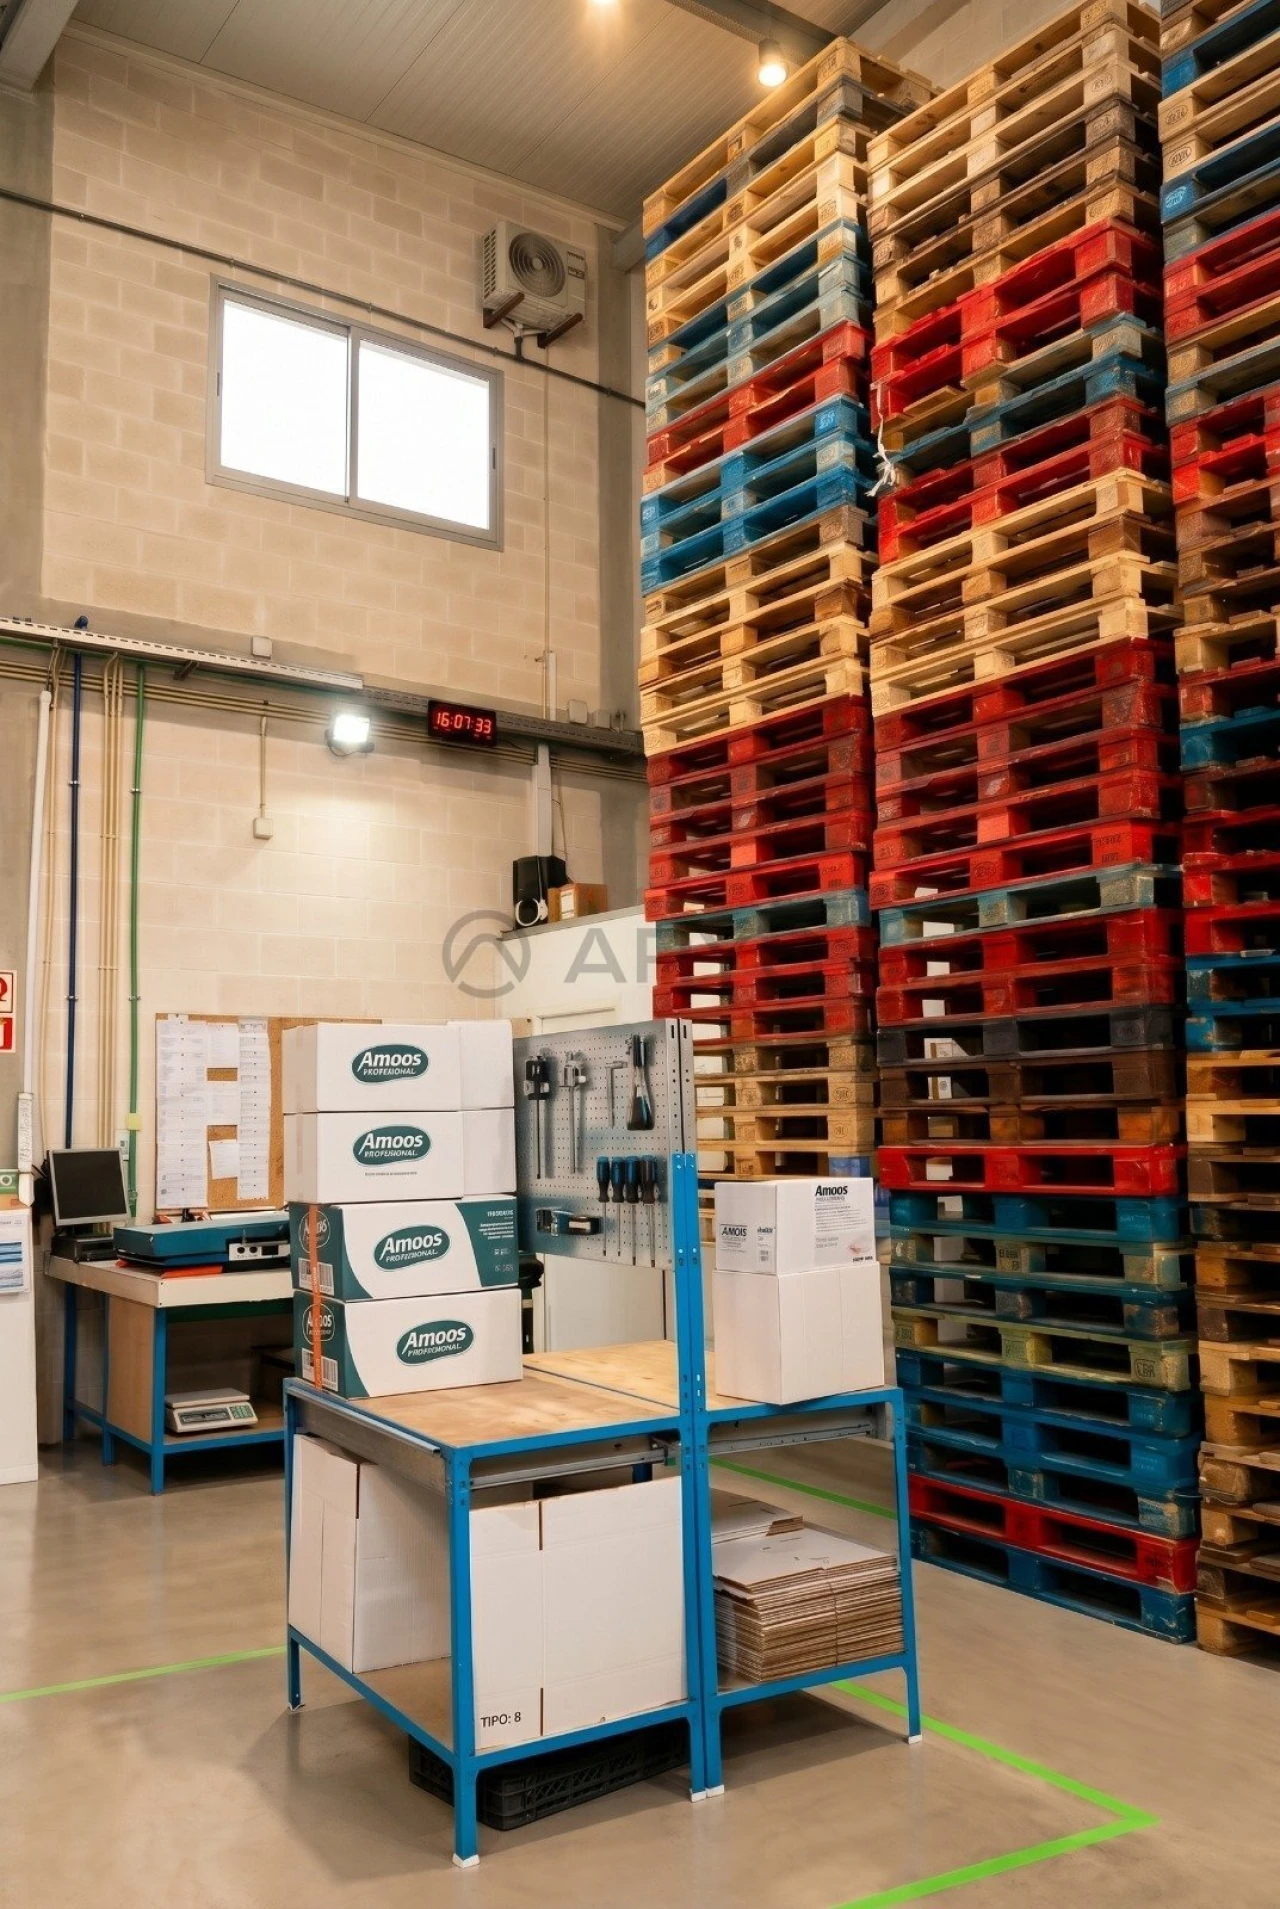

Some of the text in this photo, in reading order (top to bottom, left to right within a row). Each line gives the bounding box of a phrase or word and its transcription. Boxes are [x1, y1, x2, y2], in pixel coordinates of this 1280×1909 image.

[436, 712, 492, 734] 16:07:33
[356, 1051, 422, 1073] Amoos
[358, 1132, 423, 1156] Amoos
[814, 1184, 848, 1197] Amoos
[378, 1232, 443, 1261] Amoos
[401, 1327, 467, 1355] Amoos
[480, 1711, 521, 1728] TIPO: 8
